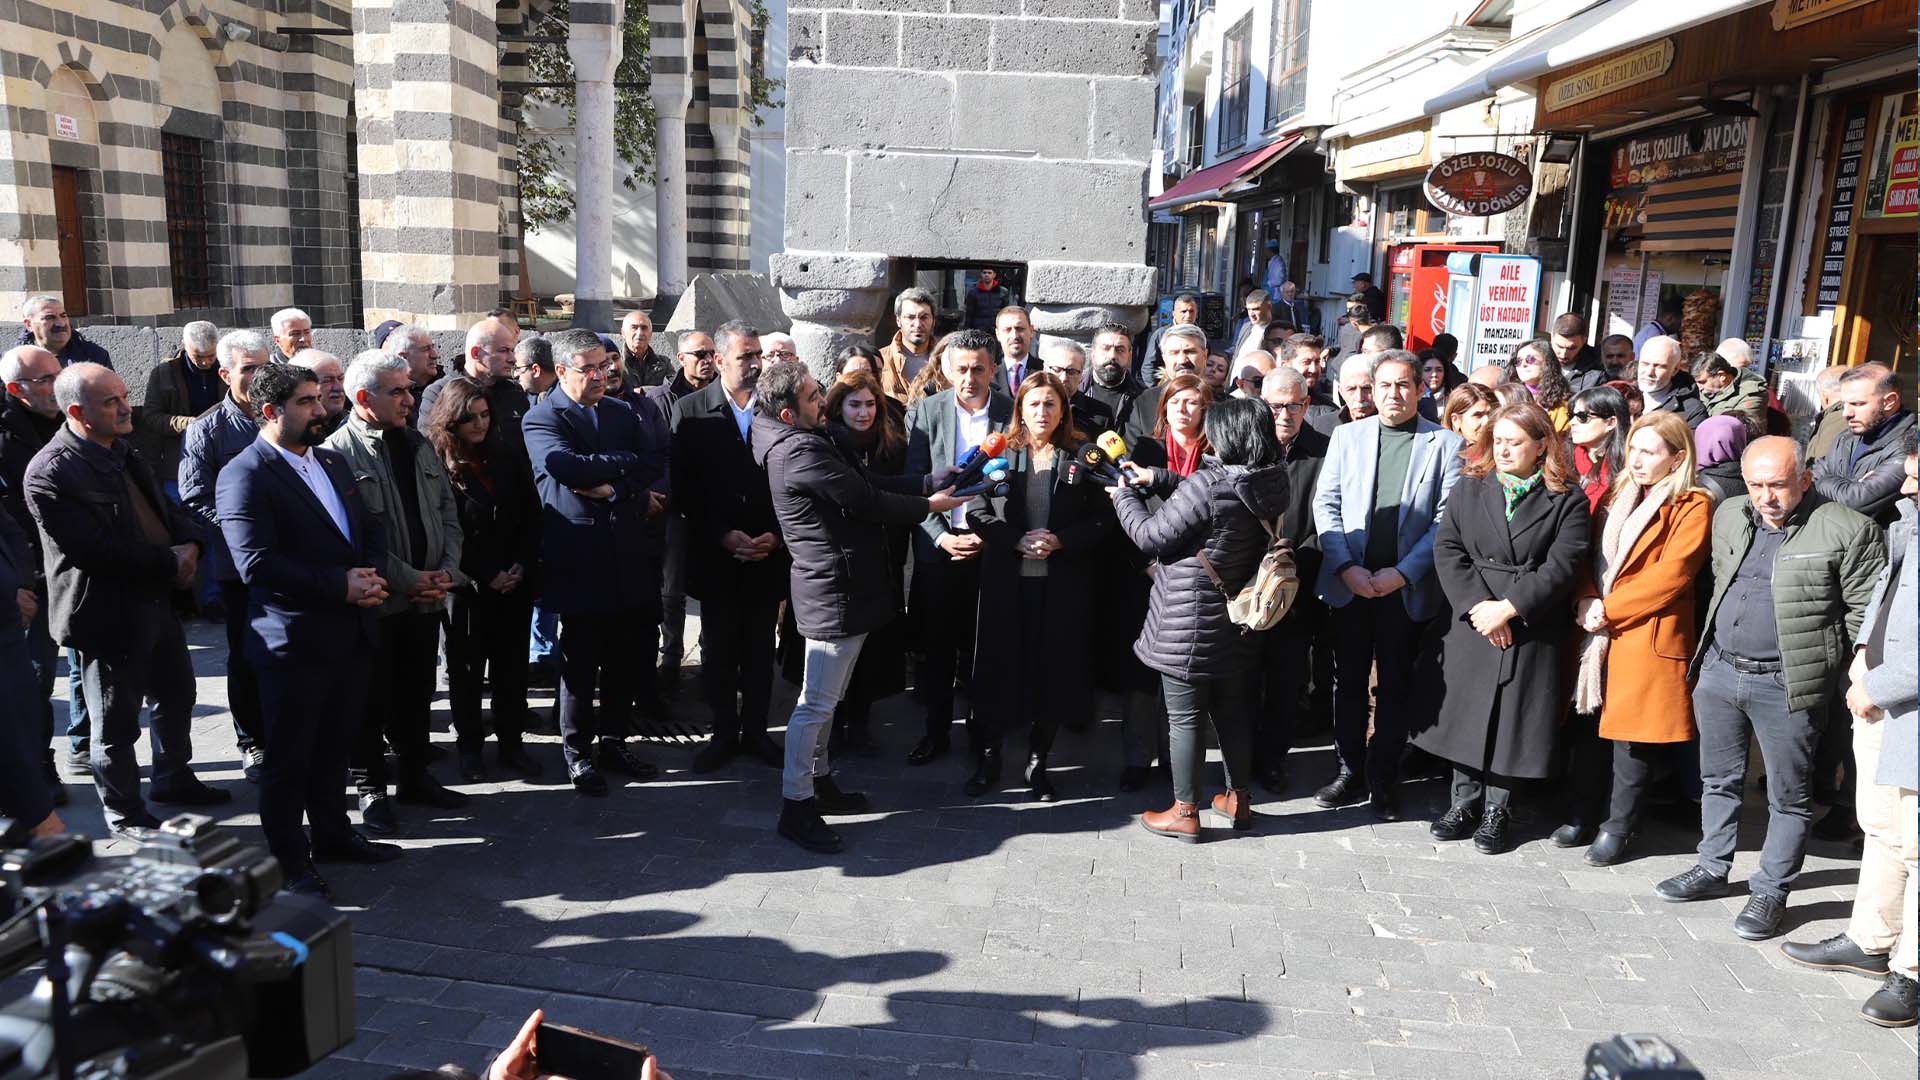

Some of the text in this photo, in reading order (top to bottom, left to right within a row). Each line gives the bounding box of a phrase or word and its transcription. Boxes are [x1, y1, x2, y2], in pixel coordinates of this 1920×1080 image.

[1576, 74, 1600, 96] SOSLU
[1602, 63, 1629, 87] HATAY
[1629, 139, 1651, 167] ÖZEL
[1652, 135, 1681, 161] SOSLU
[1682, 126, 1722, 156] HAY
[1440, 155, 1520, 177] ÖZEL SOSLU
[1432, 185, 1476, 213] HATAY
[1480, 184, 1529, 213] DÖNER
[1829, 226, 1850, 238] STRESE
[1831, 241, 1843, 253] SON
[1500, 261, 1520, 281] AİLE
[1488, 284, 1528, 302] YERİMİZ
[1480, 304, 1531, 323] ÜST KATADIR
[1484, 328, 1524, 339] MANZARALI
[1477, 343, 1497, 354] TERAS
